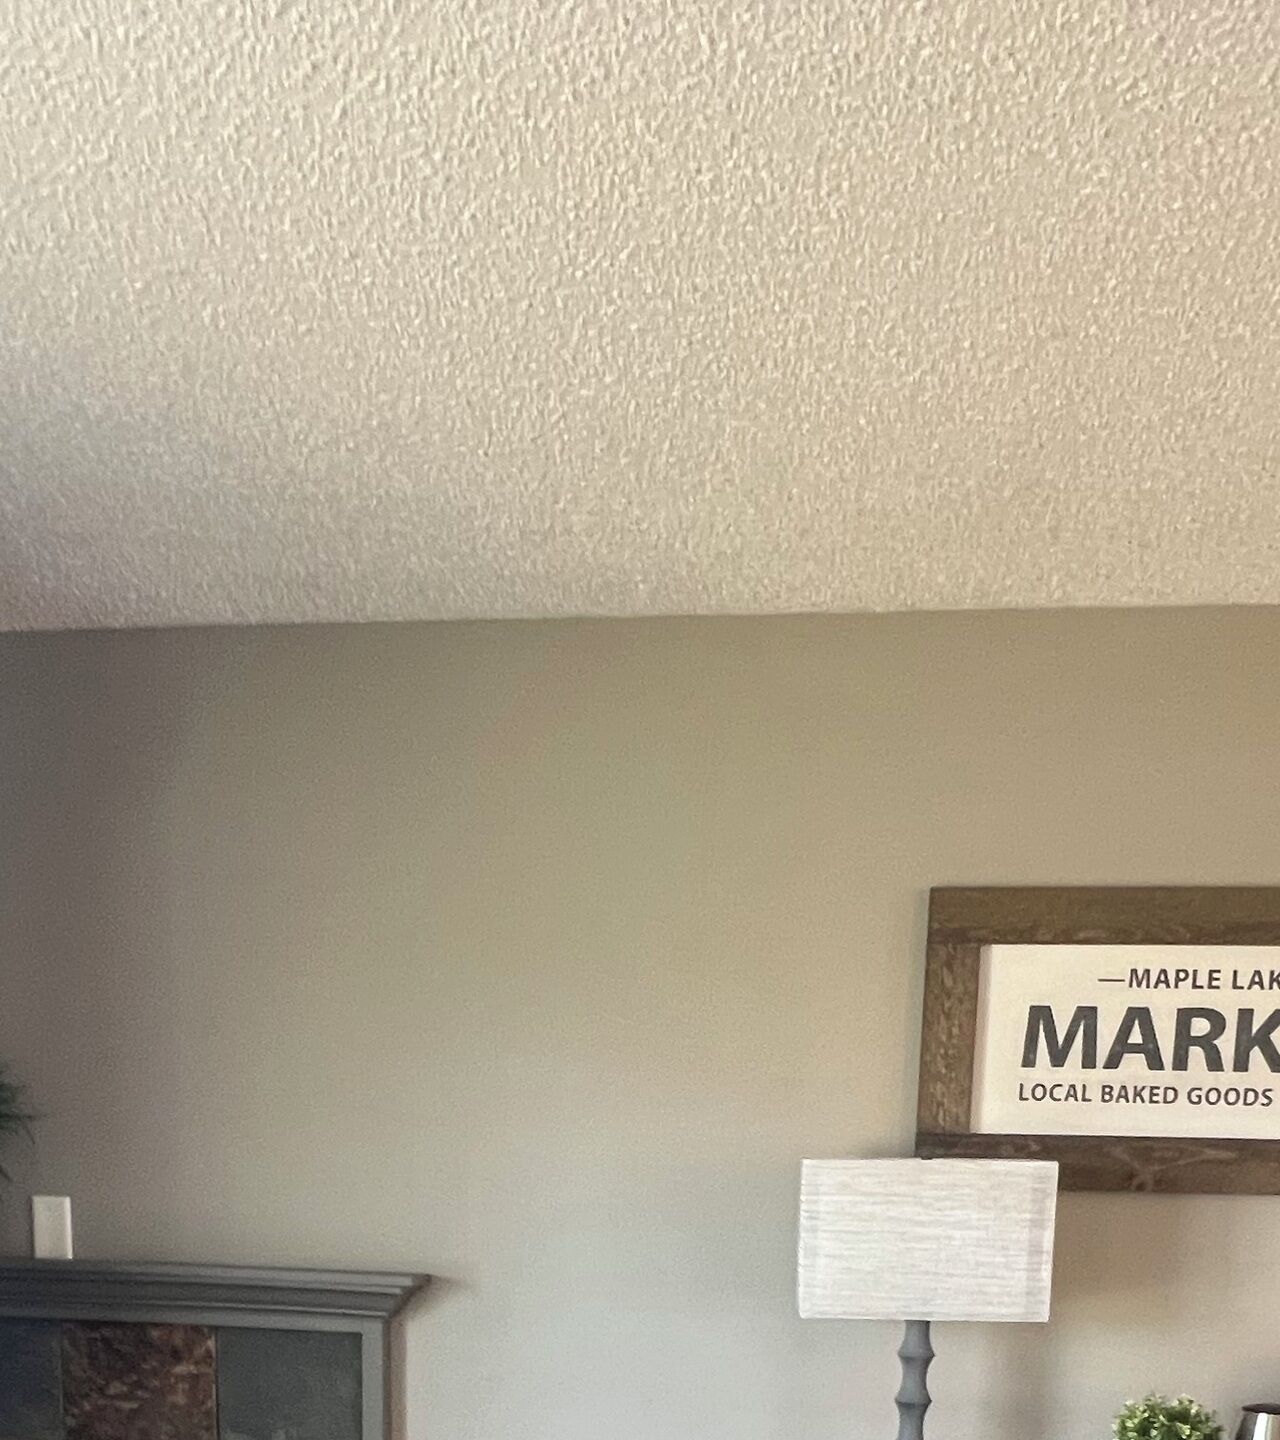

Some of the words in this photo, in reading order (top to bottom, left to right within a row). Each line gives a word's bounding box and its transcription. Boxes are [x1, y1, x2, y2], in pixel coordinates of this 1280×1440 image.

[1018, 1082, 1093, 1104] LOCAL
[1100, 1084, 1179, 1106] BAKED
[1186, 1086, 1273, 1109] GOODS
